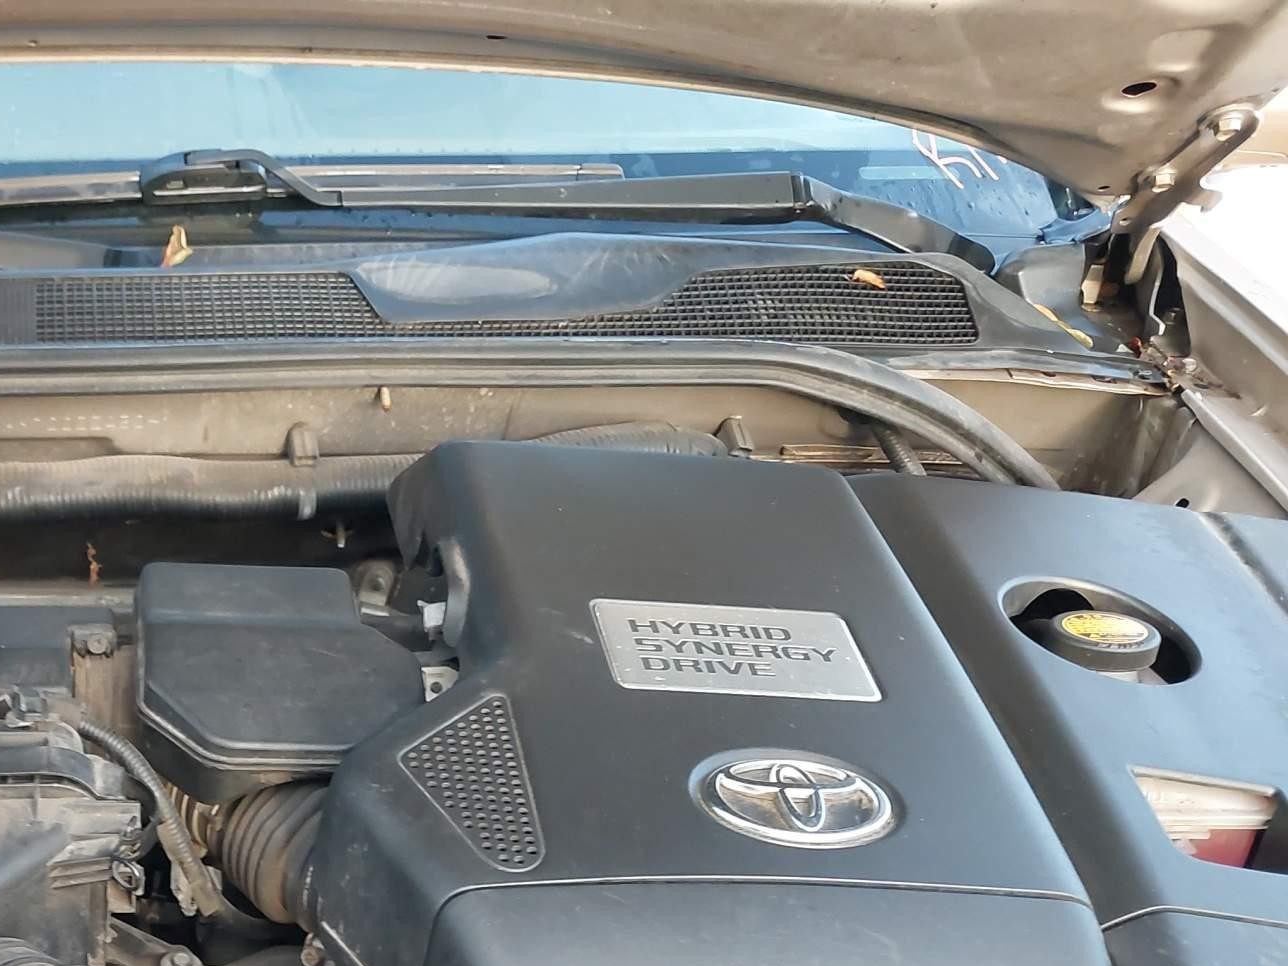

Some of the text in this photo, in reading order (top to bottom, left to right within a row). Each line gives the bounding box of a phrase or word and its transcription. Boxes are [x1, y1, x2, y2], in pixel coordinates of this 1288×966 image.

[626, 618, 792, 642] HYBRID
[633, 637, 837, 663] SYNERGY
[639, 656, 778, 678] DRIVE
